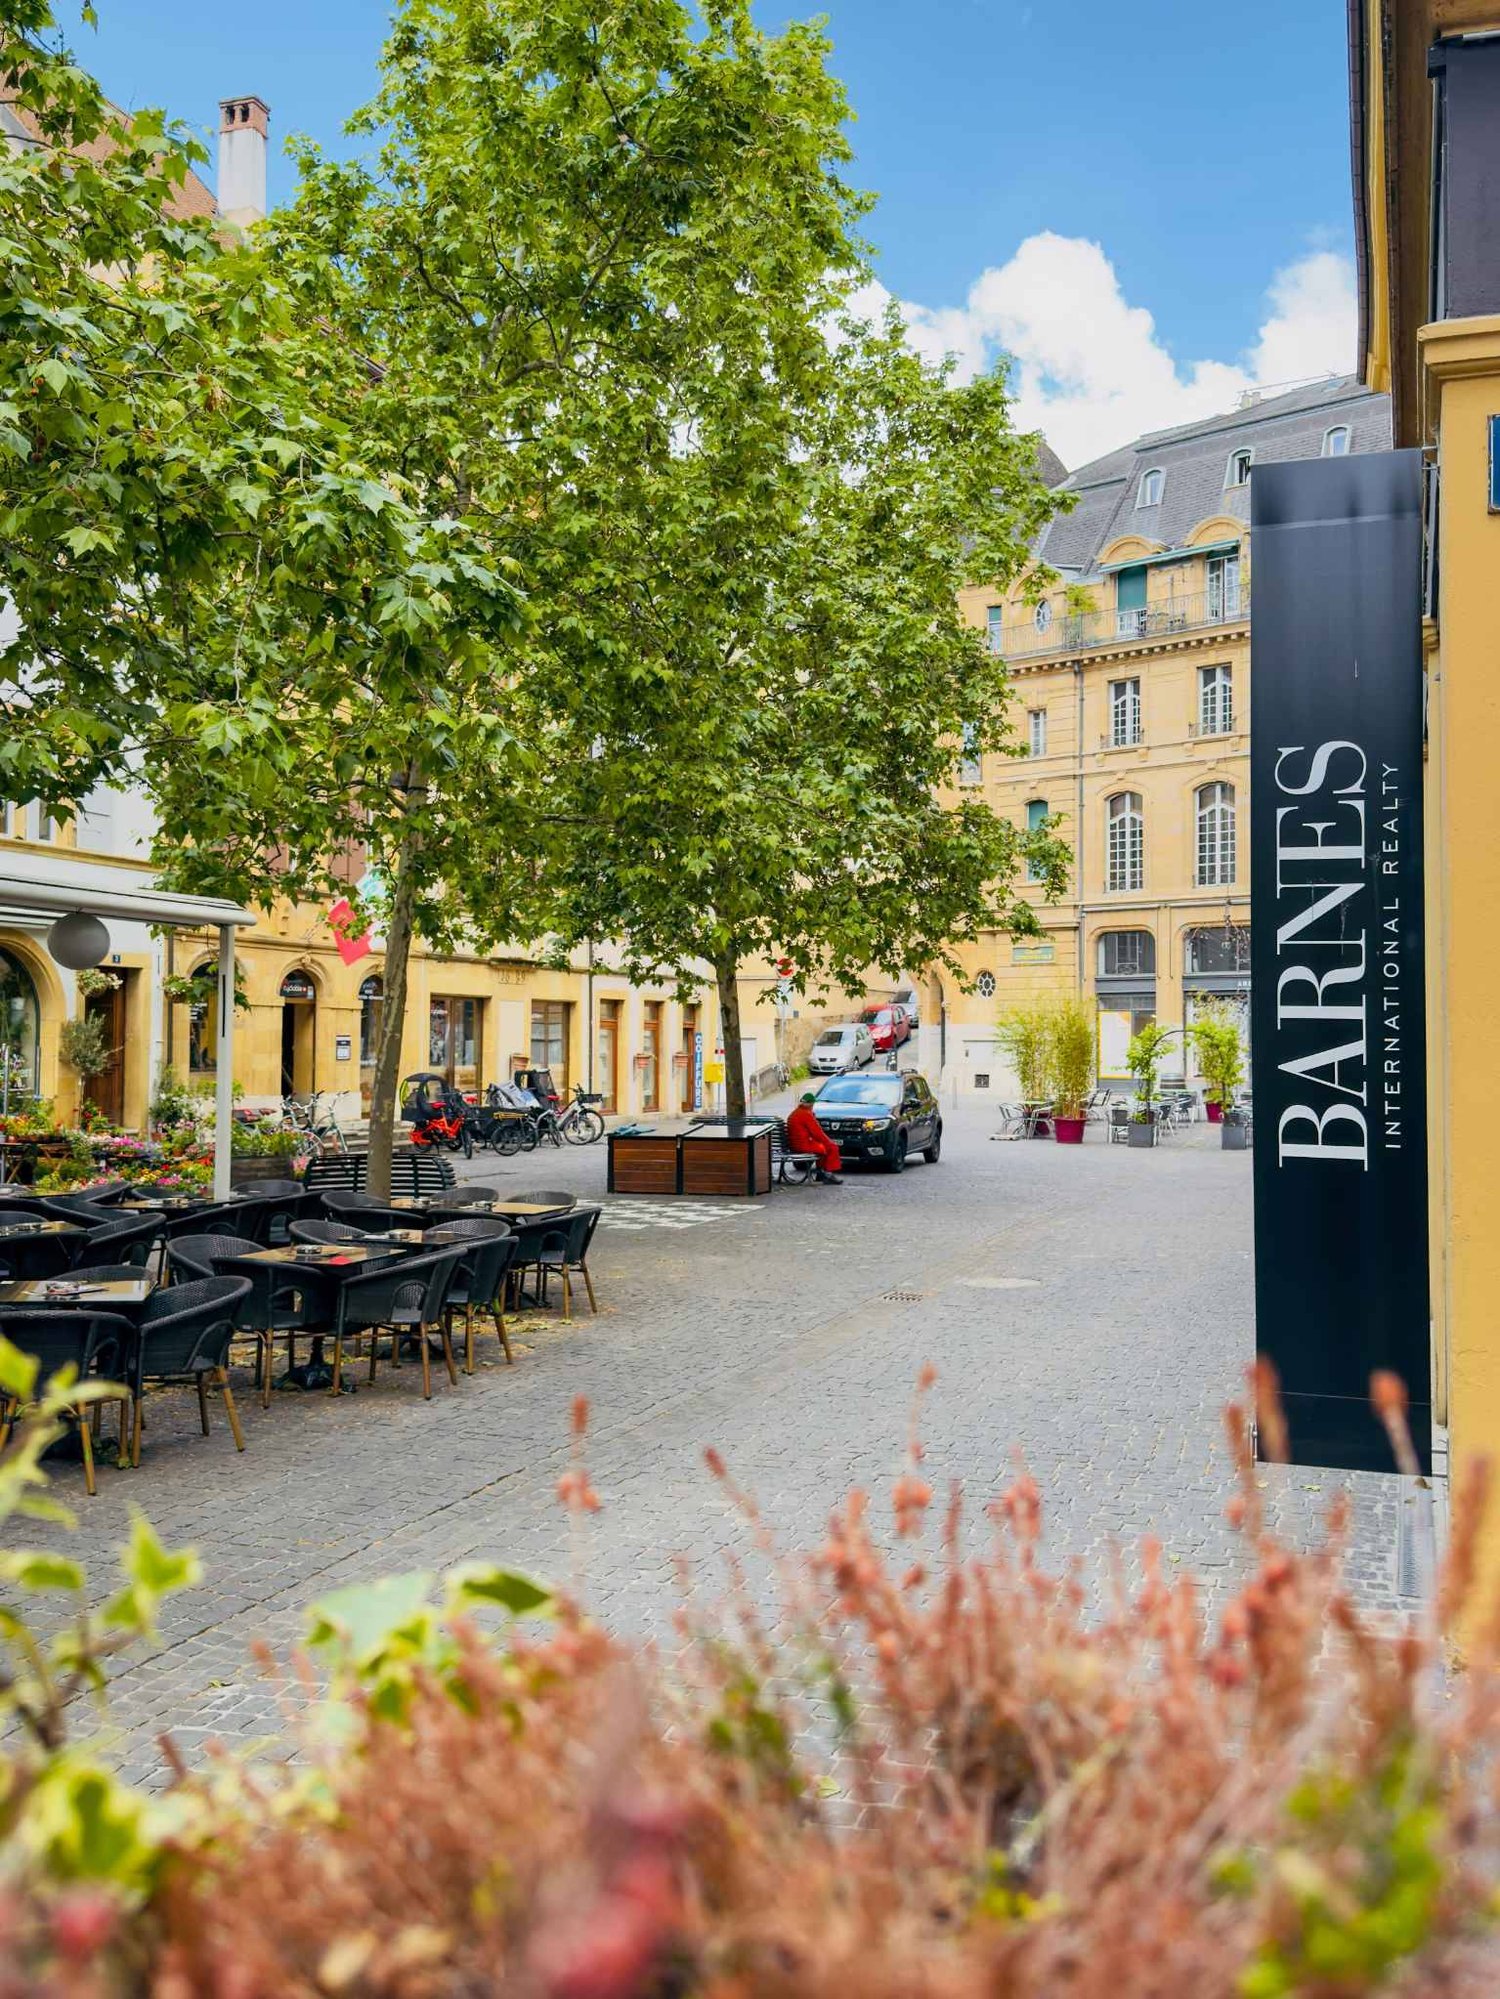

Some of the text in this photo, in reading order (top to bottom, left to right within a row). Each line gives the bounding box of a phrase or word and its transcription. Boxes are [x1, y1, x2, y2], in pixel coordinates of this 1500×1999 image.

[1274, 740, 1369, 1172] BARNES
[1382, 762, 1402, 1149] INTERNATIONAL REALTY
